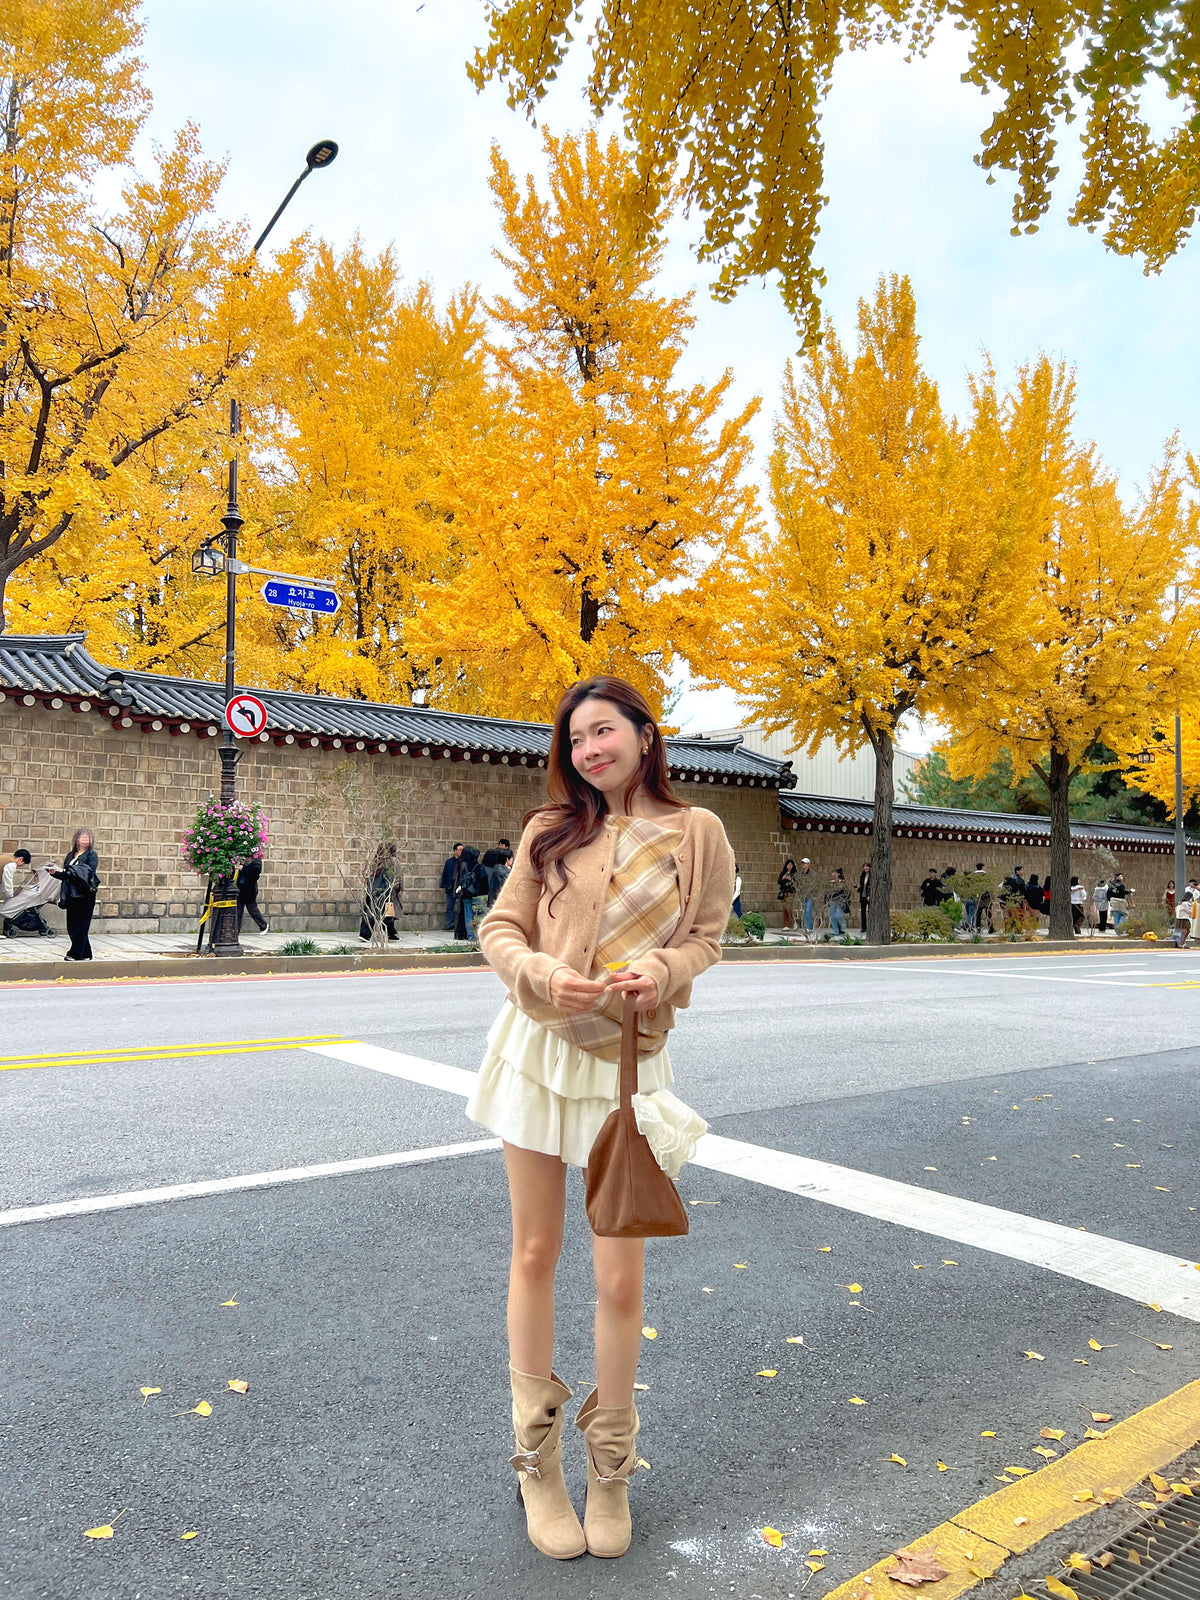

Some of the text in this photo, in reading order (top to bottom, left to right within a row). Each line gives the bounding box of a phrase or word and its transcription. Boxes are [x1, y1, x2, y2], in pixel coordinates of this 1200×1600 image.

[268, 588, 278, 597] 28
[288, 587, 316, 599] 효자로
[288, 598, 315, 609] Hyoja-ro
[325, 598, 334, 606] 24
